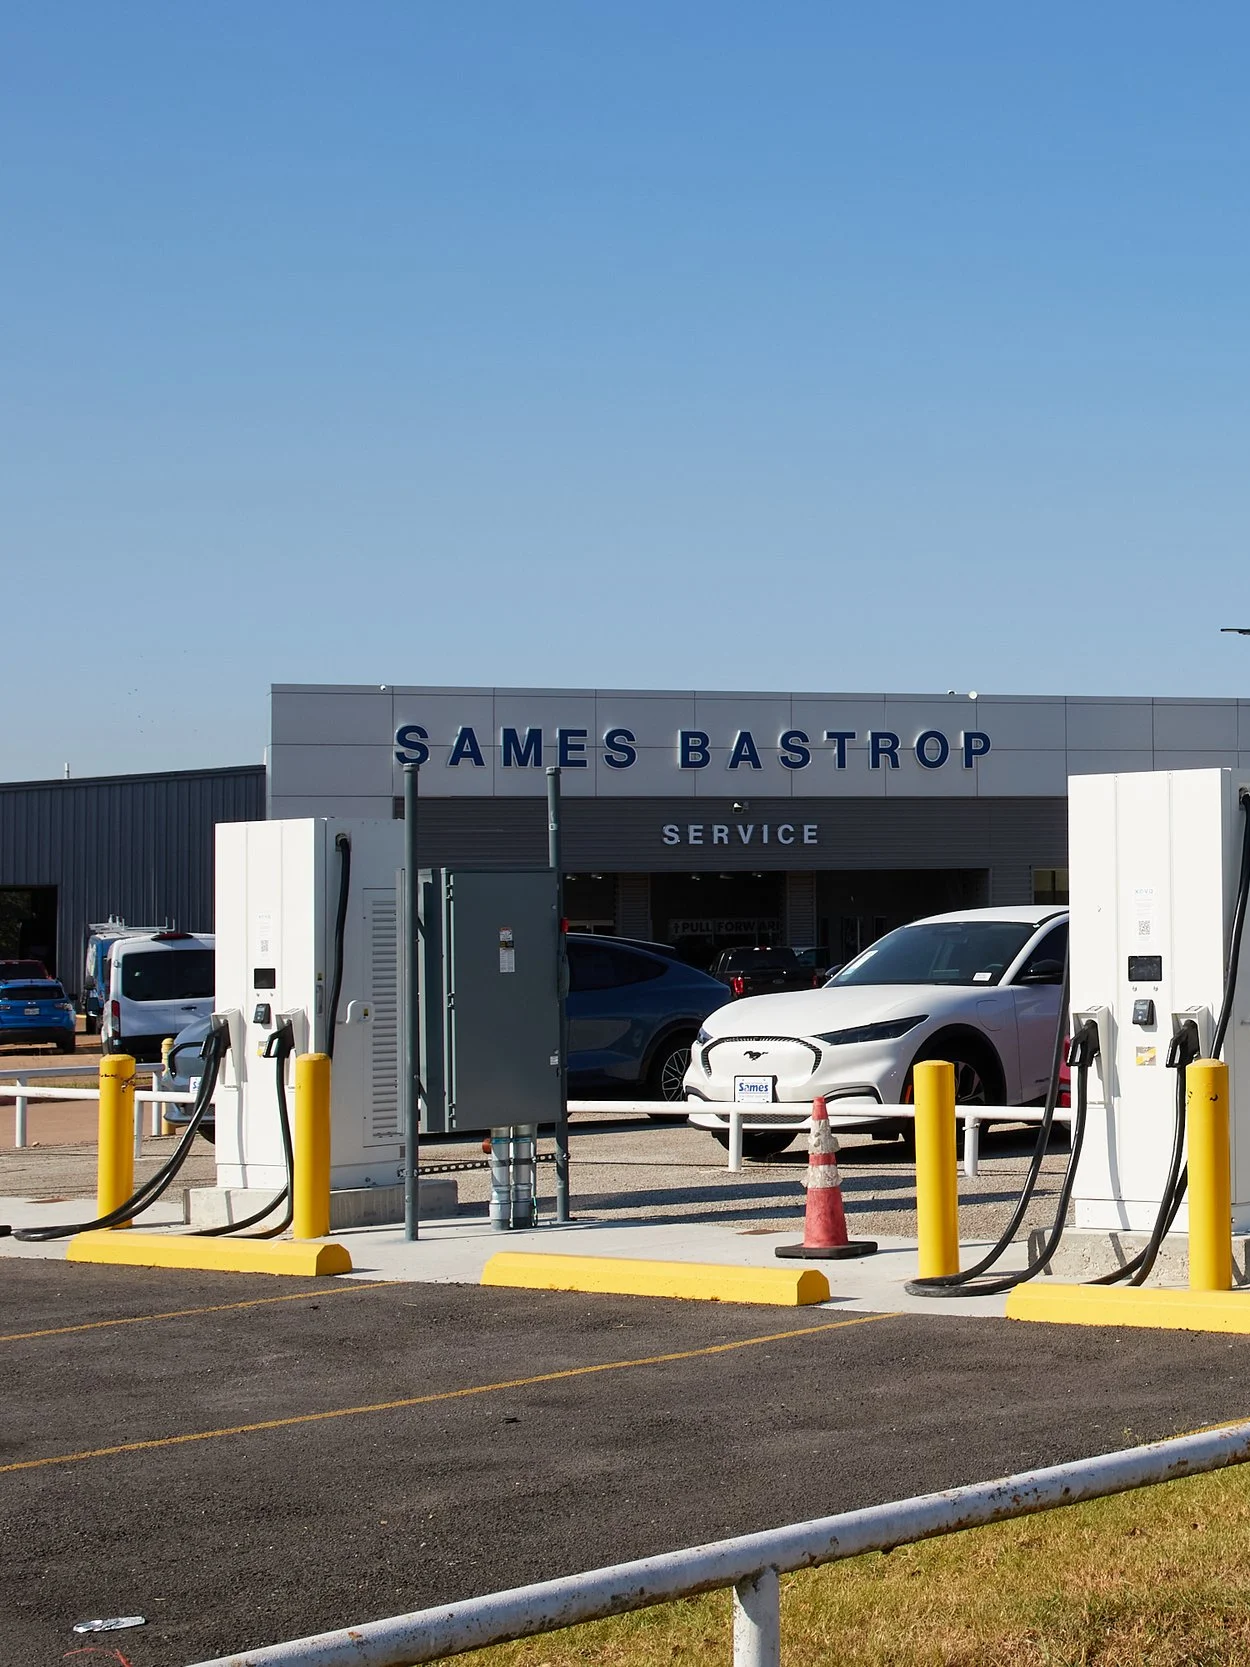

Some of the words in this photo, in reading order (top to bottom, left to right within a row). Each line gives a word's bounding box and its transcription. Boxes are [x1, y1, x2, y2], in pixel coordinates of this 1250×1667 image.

[394, 724, 638, 769] SAMES
[678, 729, 992, 770] BASTROP
[662, 824, 818, 845] SERVICE
[682, 921, 712, 932] PULL
[738, 1082, 769, 1092] Sames
